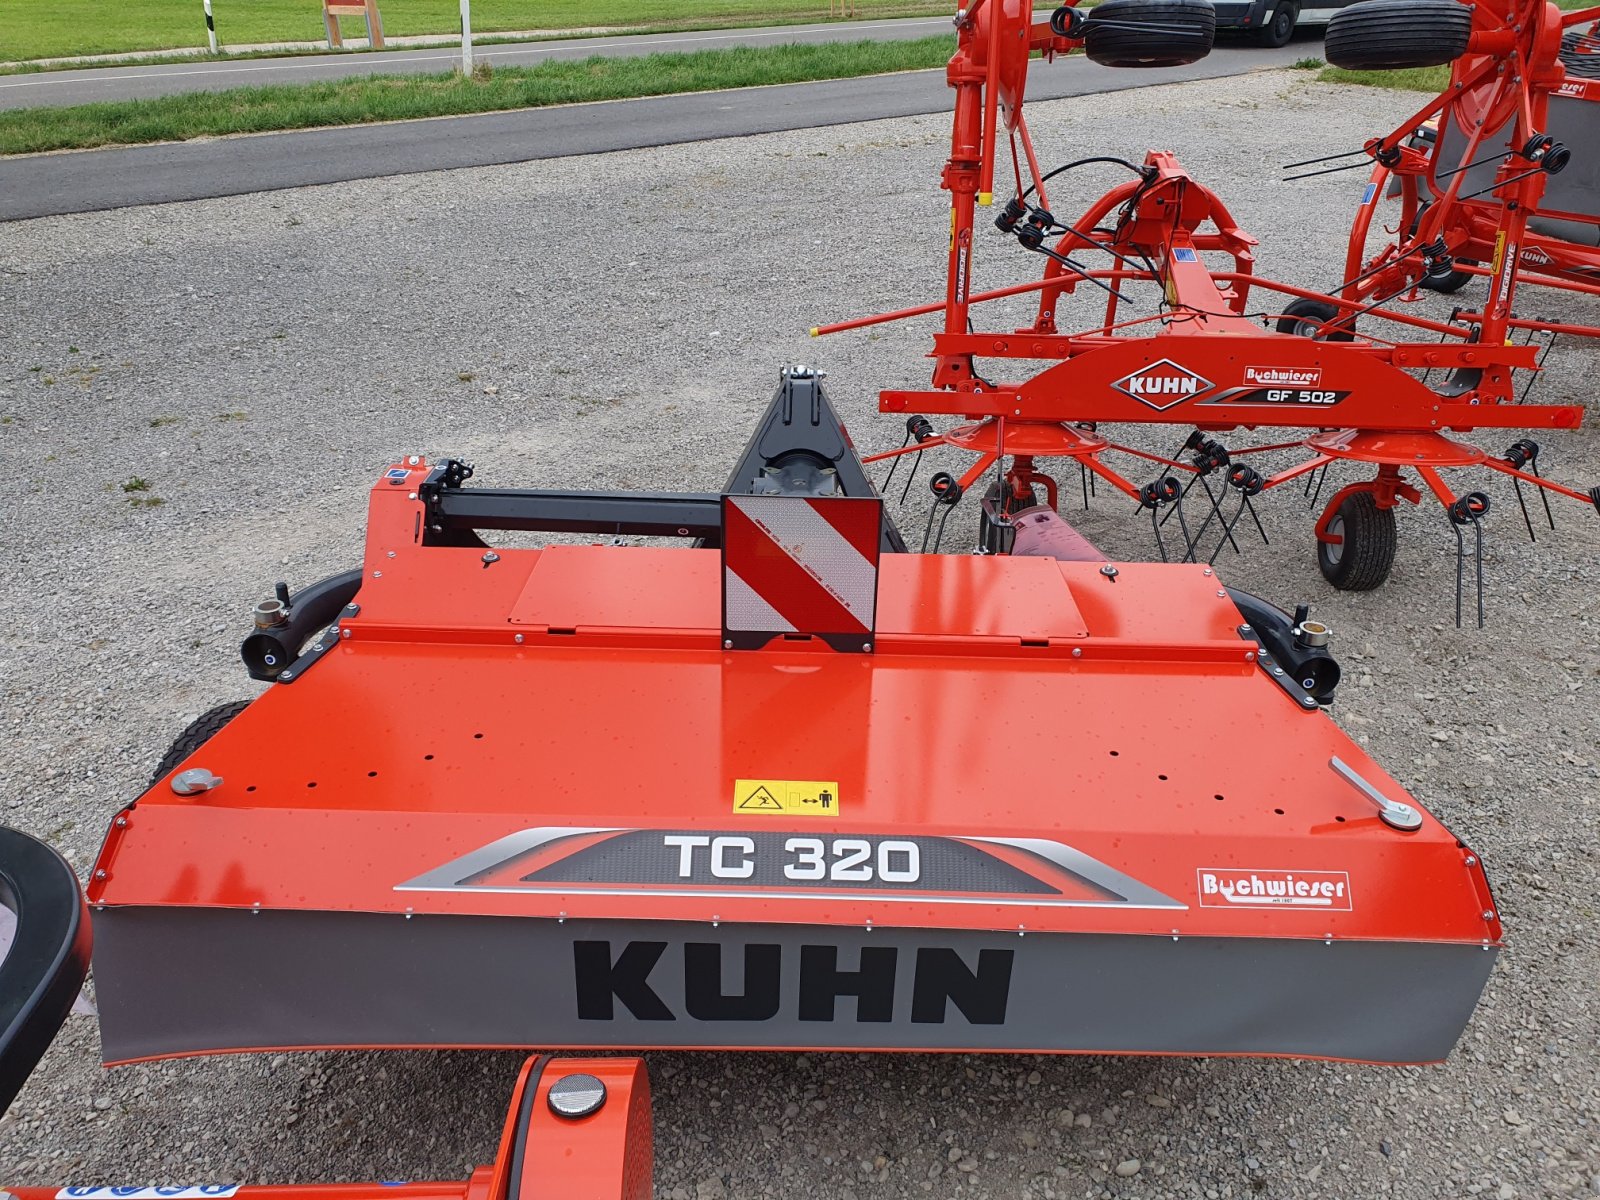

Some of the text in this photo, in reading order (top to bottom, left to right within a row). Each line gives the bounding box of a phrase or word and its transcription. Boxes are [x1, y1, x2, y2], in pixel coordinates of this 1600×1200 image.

[1499, 242, 1516, 302] DIGIDRIVE
[1129, 377, 1197, 394] KUHN
[1246, 368, 1318, 383] Buchwieser
[1267, 390, 1335, 403] GF 502
[664, 835, 920, 882] TC 320
[1203, 874, 1344, 898] Buchwieser
[573, 941, 1014, 1024] KUHN
